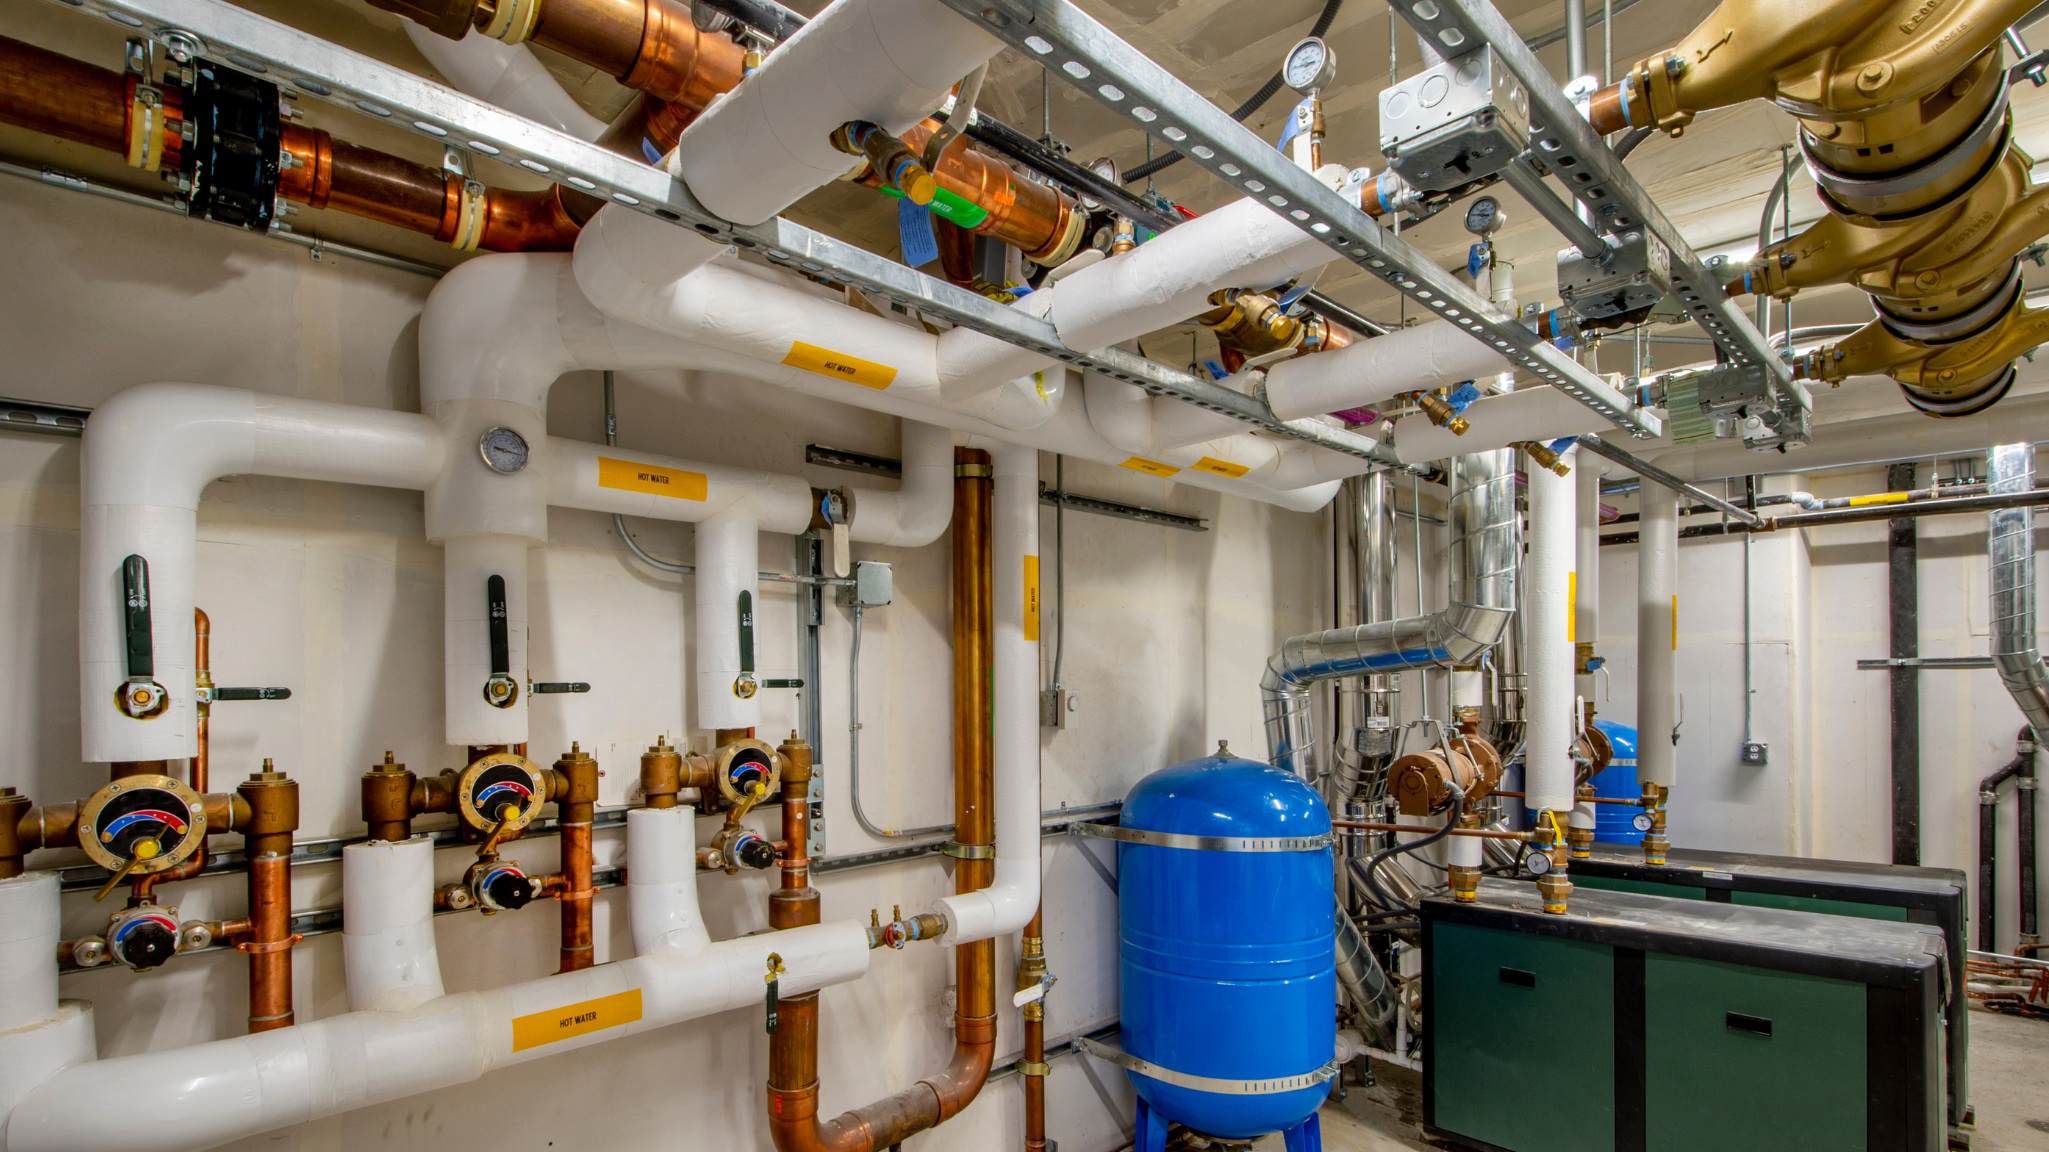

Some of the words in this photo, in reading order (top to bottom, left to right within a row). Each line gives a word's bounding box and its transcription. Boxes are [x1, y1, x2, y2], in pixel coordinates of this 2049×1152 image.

[931, 200, 953, 213] WATER
[824, 361, 838, 370] HOT
[837, 364, 857, 375] WATER
[638, 472, 649, 481] HOT
[650, 474, 669, 484] WATER
[560, 1017, 573, 1028] HOT
[574, 1012, 597, 1025] WATER
